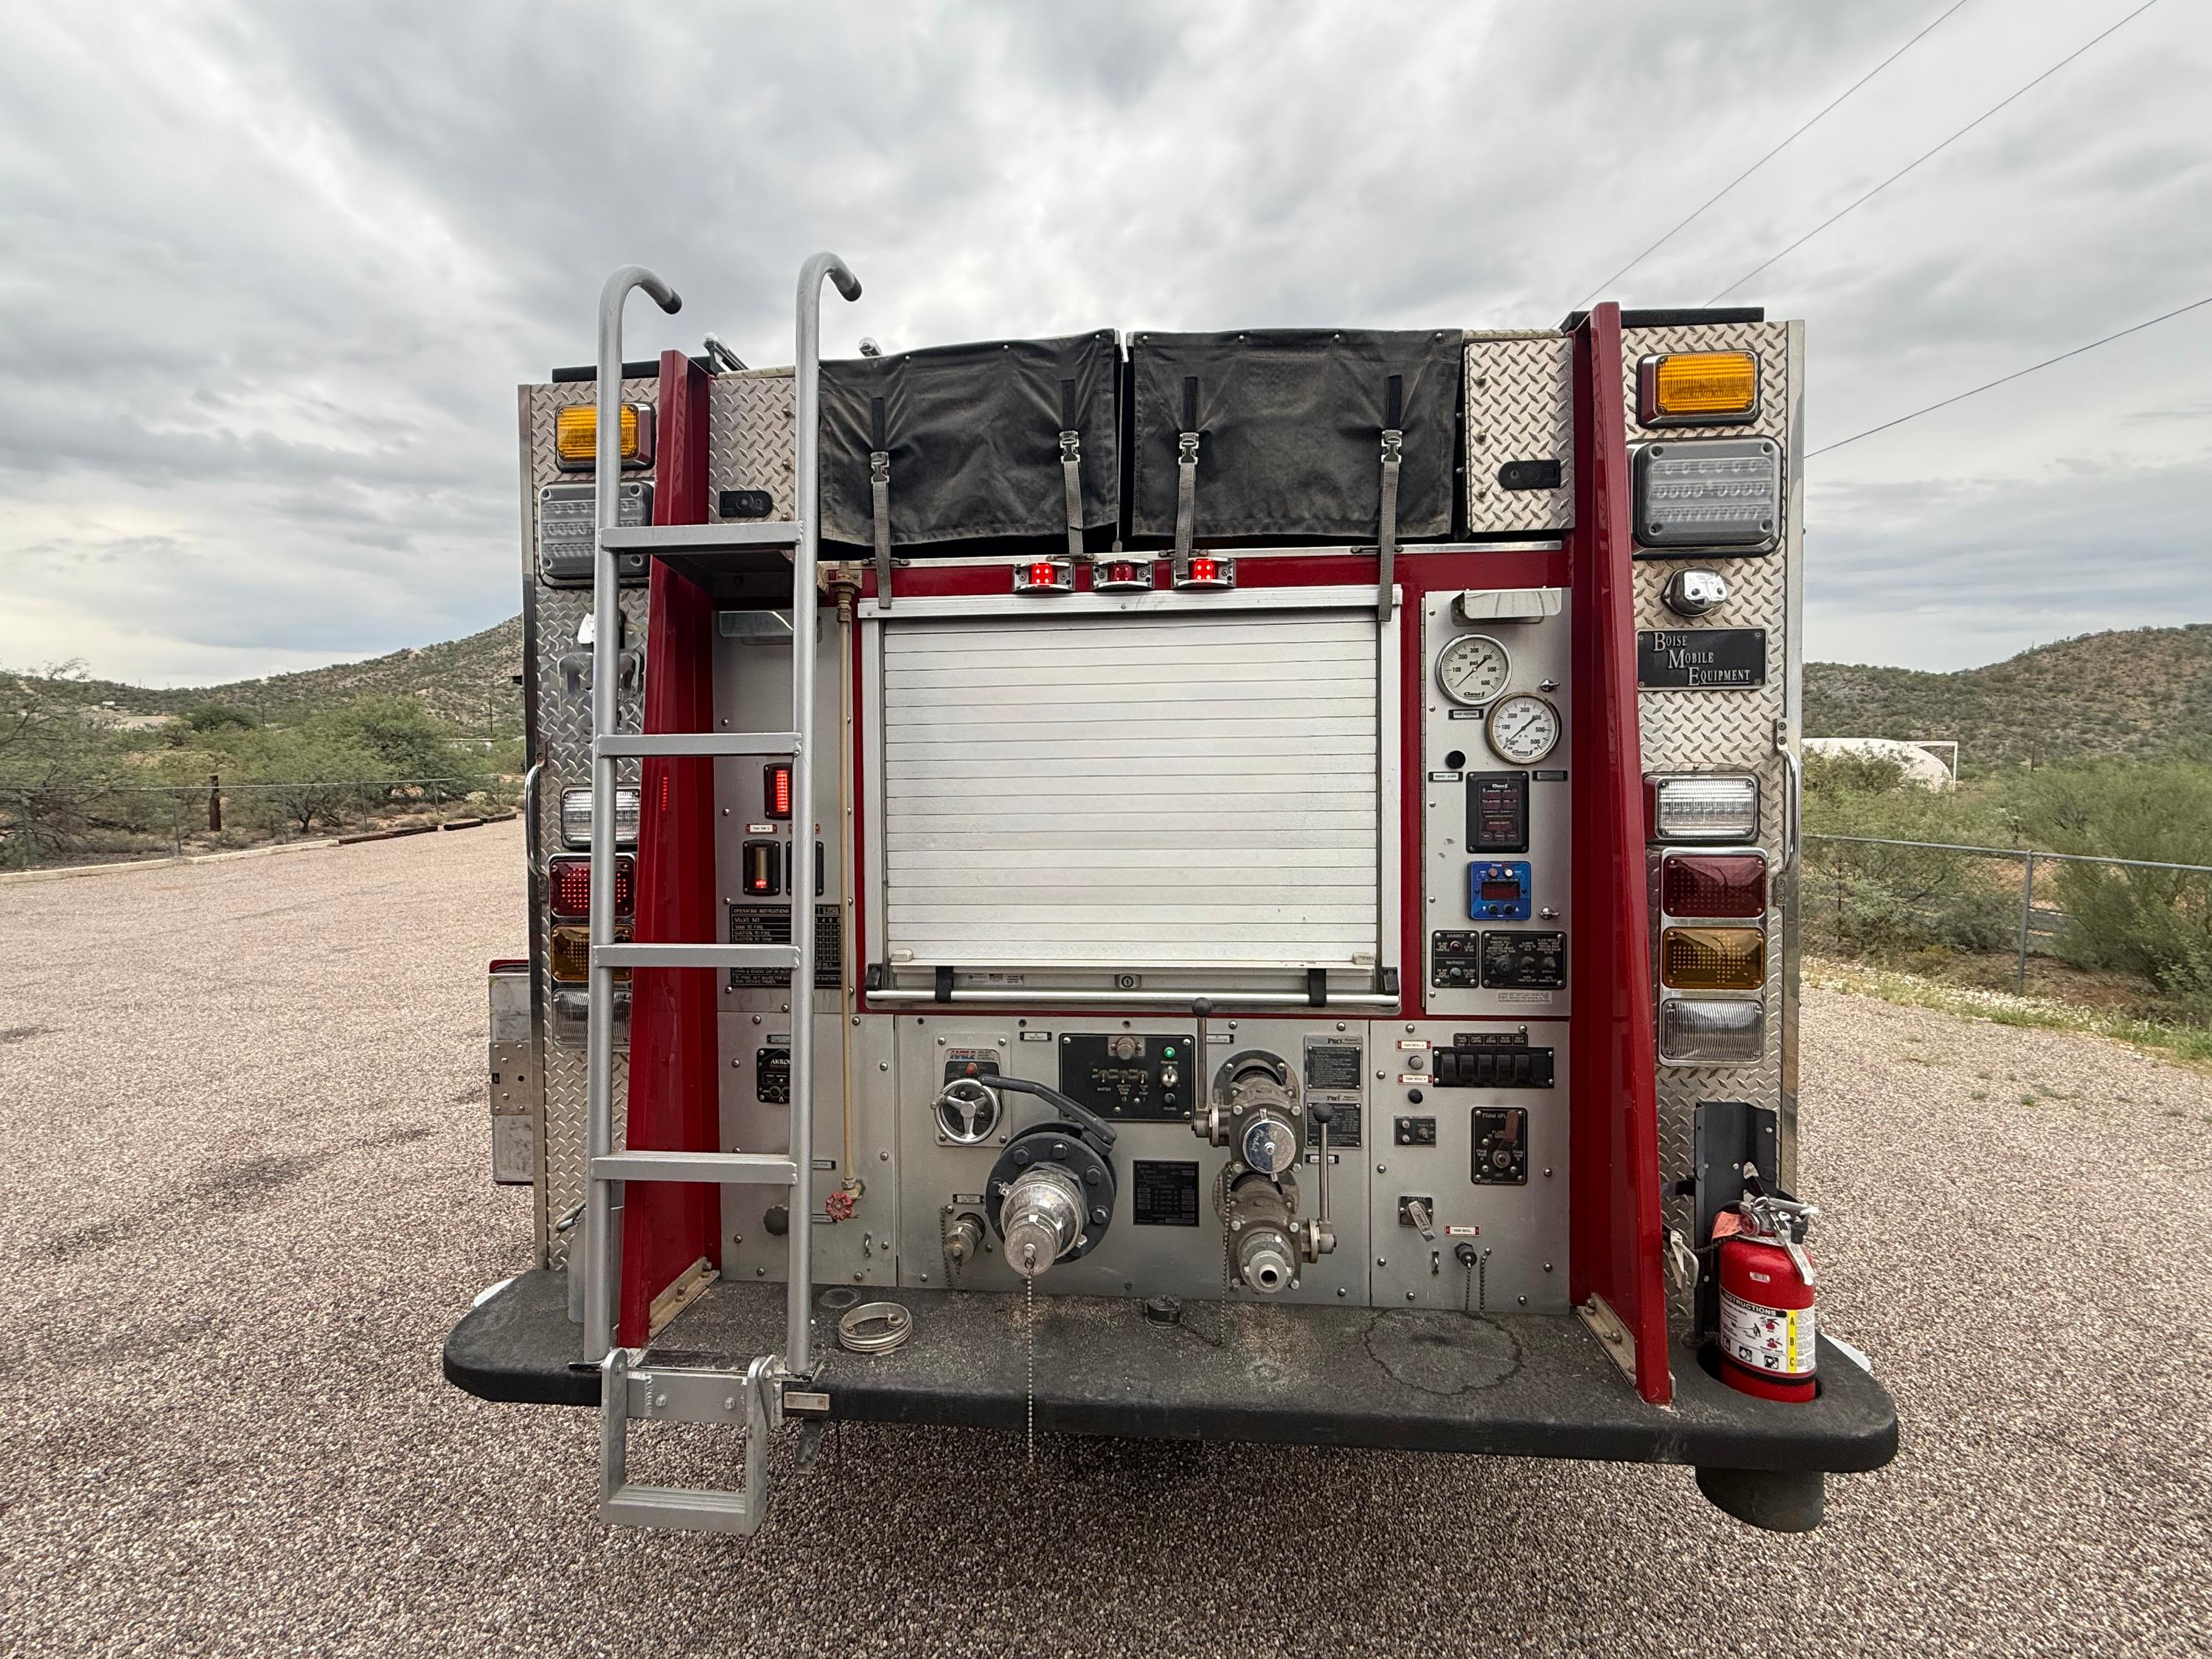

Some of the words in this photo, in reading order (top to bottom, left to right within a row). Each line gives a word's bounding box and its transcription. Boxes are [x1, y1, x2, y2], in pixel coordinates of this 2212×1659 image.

[1688, 667, 1750, 686] EQUIPMENT
[1724, 1292, 1776, 1316] INSTRUCTIONS
[1790, 1317, 1795, 1326] A
[1790, 1337, 1795, 1346] B
[1790, 1357, 1795, 1366] C
